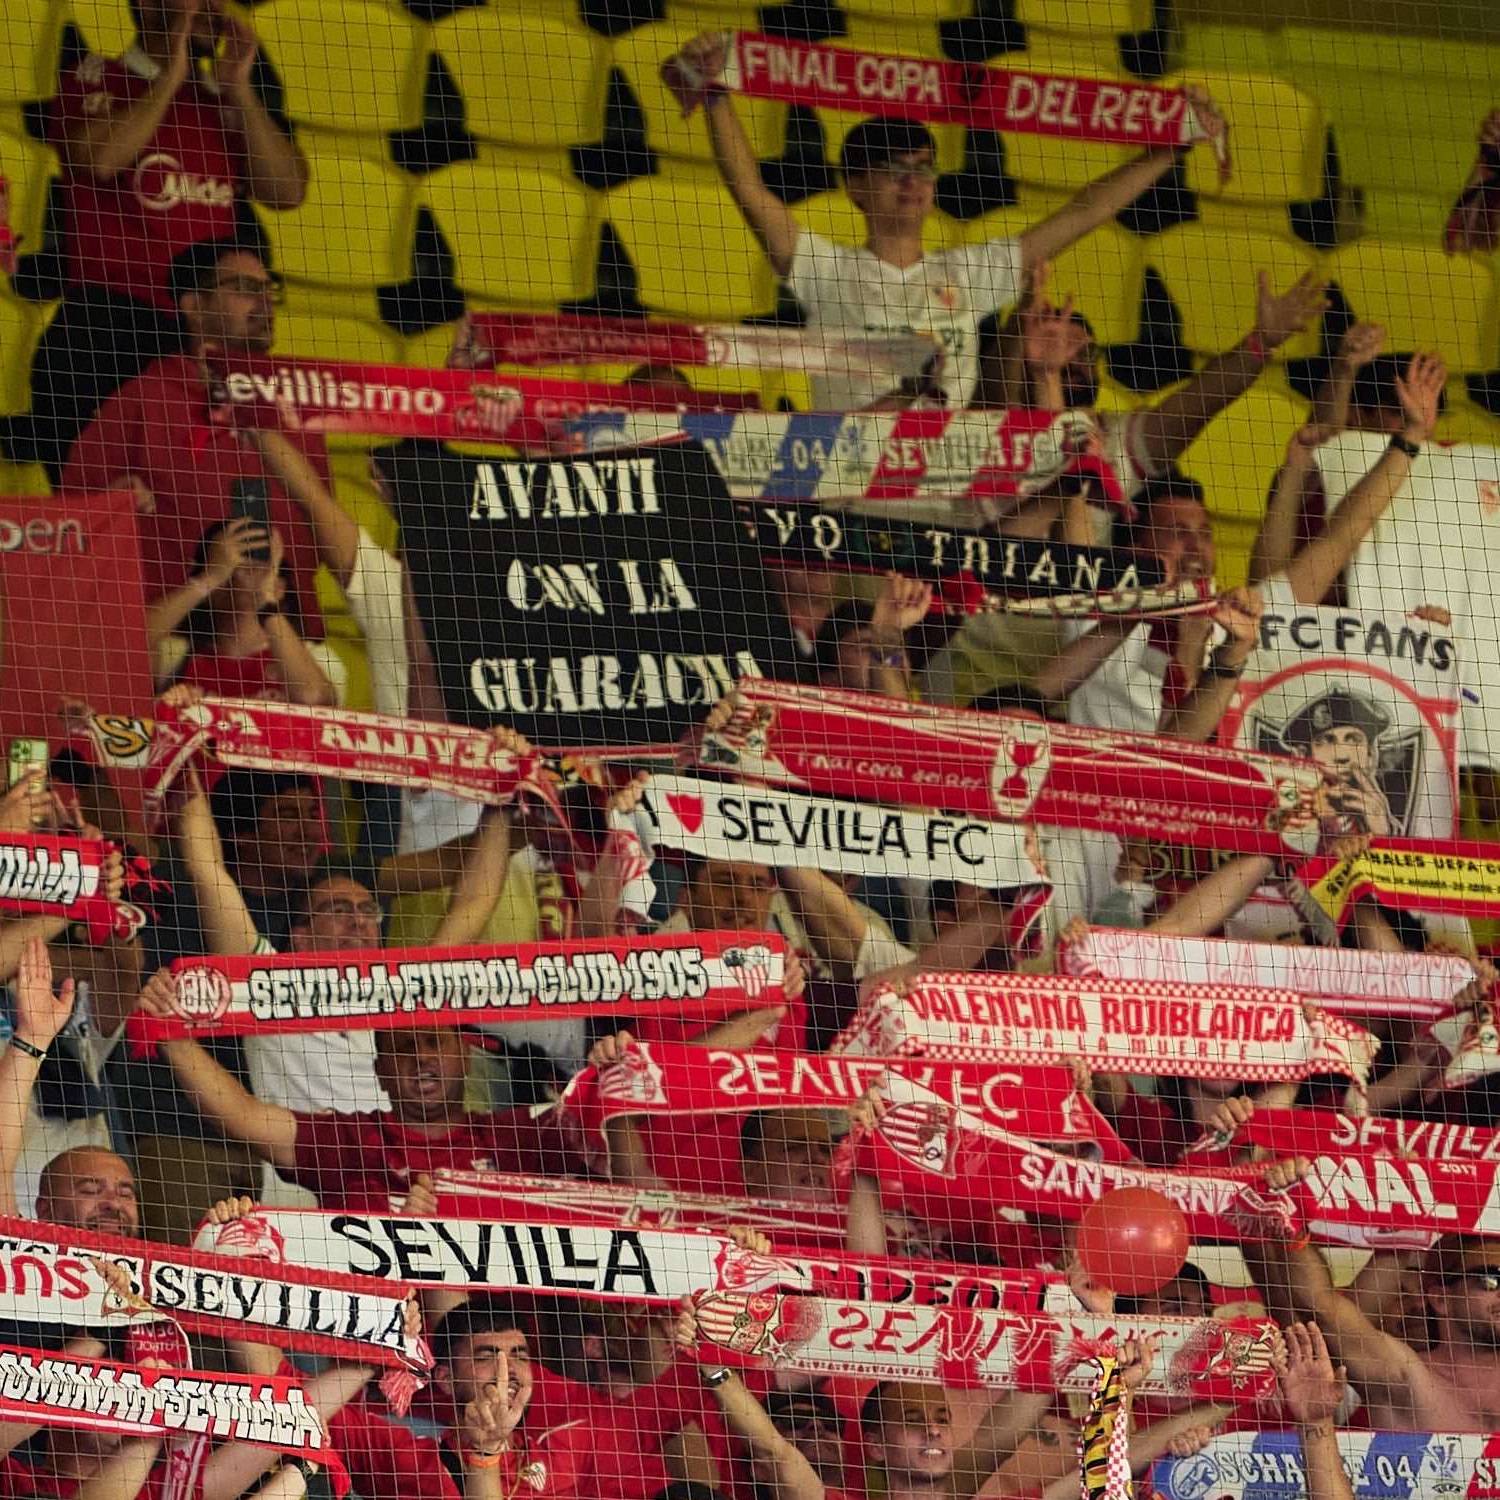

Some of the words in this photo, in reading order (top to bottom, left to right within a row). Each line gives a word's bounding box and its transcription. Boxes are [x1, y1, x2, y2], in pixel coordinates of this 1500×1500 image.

[744, 40, 848, 94] FINAL
[855, 56, 943, 102] COPA
[1006, 74, 1083, 125] DEL
[1090, 86, 1183, 135] REY
[470, 458, 661, 521] AVANTI
[506, 557, 605, 615] CON
[621, 559, 697, 614] LA
[1335, 616, 1455, 670] FANS
[717, 797, 910, 860] SEVILLA
[926, 822, 988, 867] FC
[249, 965, 392, 1020] SEVILLA
[534, 954, 627, 1006] CLUB
[907, 990, 1087, 1035] VALENCINA
[1103, 1000, 1296, 1045] ROJIBLANCA
[958, 1024, 1056, 1051] HASTA
[1076, 1031, 1105, 1053] LA
[1129, 1038, 1249, 1061] MUERTE
[1018, 1156, 1101, 1201] SAN
[330, 1216, 657, 1295] SEVILLA
[153, 1261, 408, 1347] SEVILLA
[1376, 1454, 1417, 1488] 04
